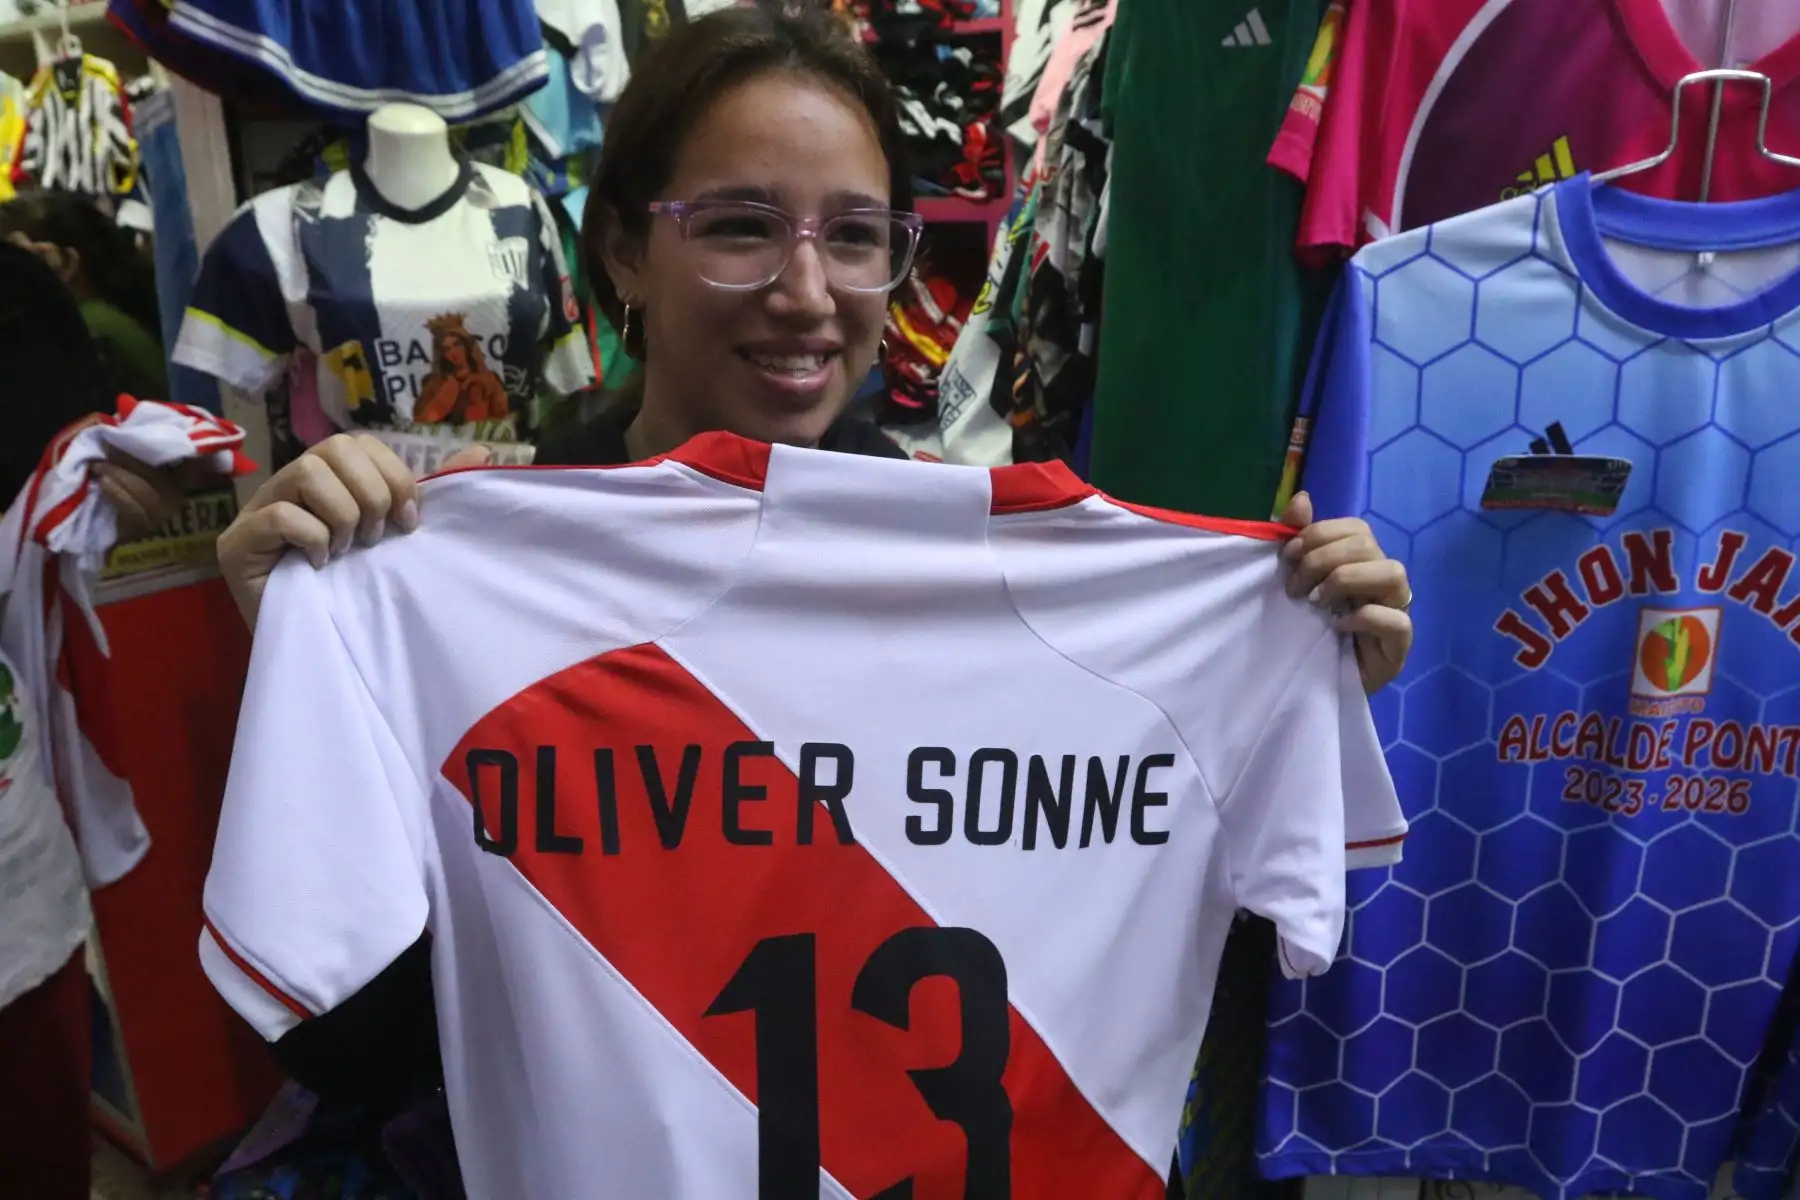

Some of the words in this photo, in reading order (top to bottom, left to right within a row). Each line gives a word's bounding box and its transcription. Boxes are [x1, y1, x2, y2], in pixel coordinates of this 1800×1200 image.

[379, 333, 508, 368] BAO
[1494, 529, 1680, 671] JHON
[466, 741, 856, 857] OLIVER
[905, 746, 1175, 851] SONNE
[1498, 711, 1678, 772] ALCALDE
[702, 926, 1013, 1200] 13
